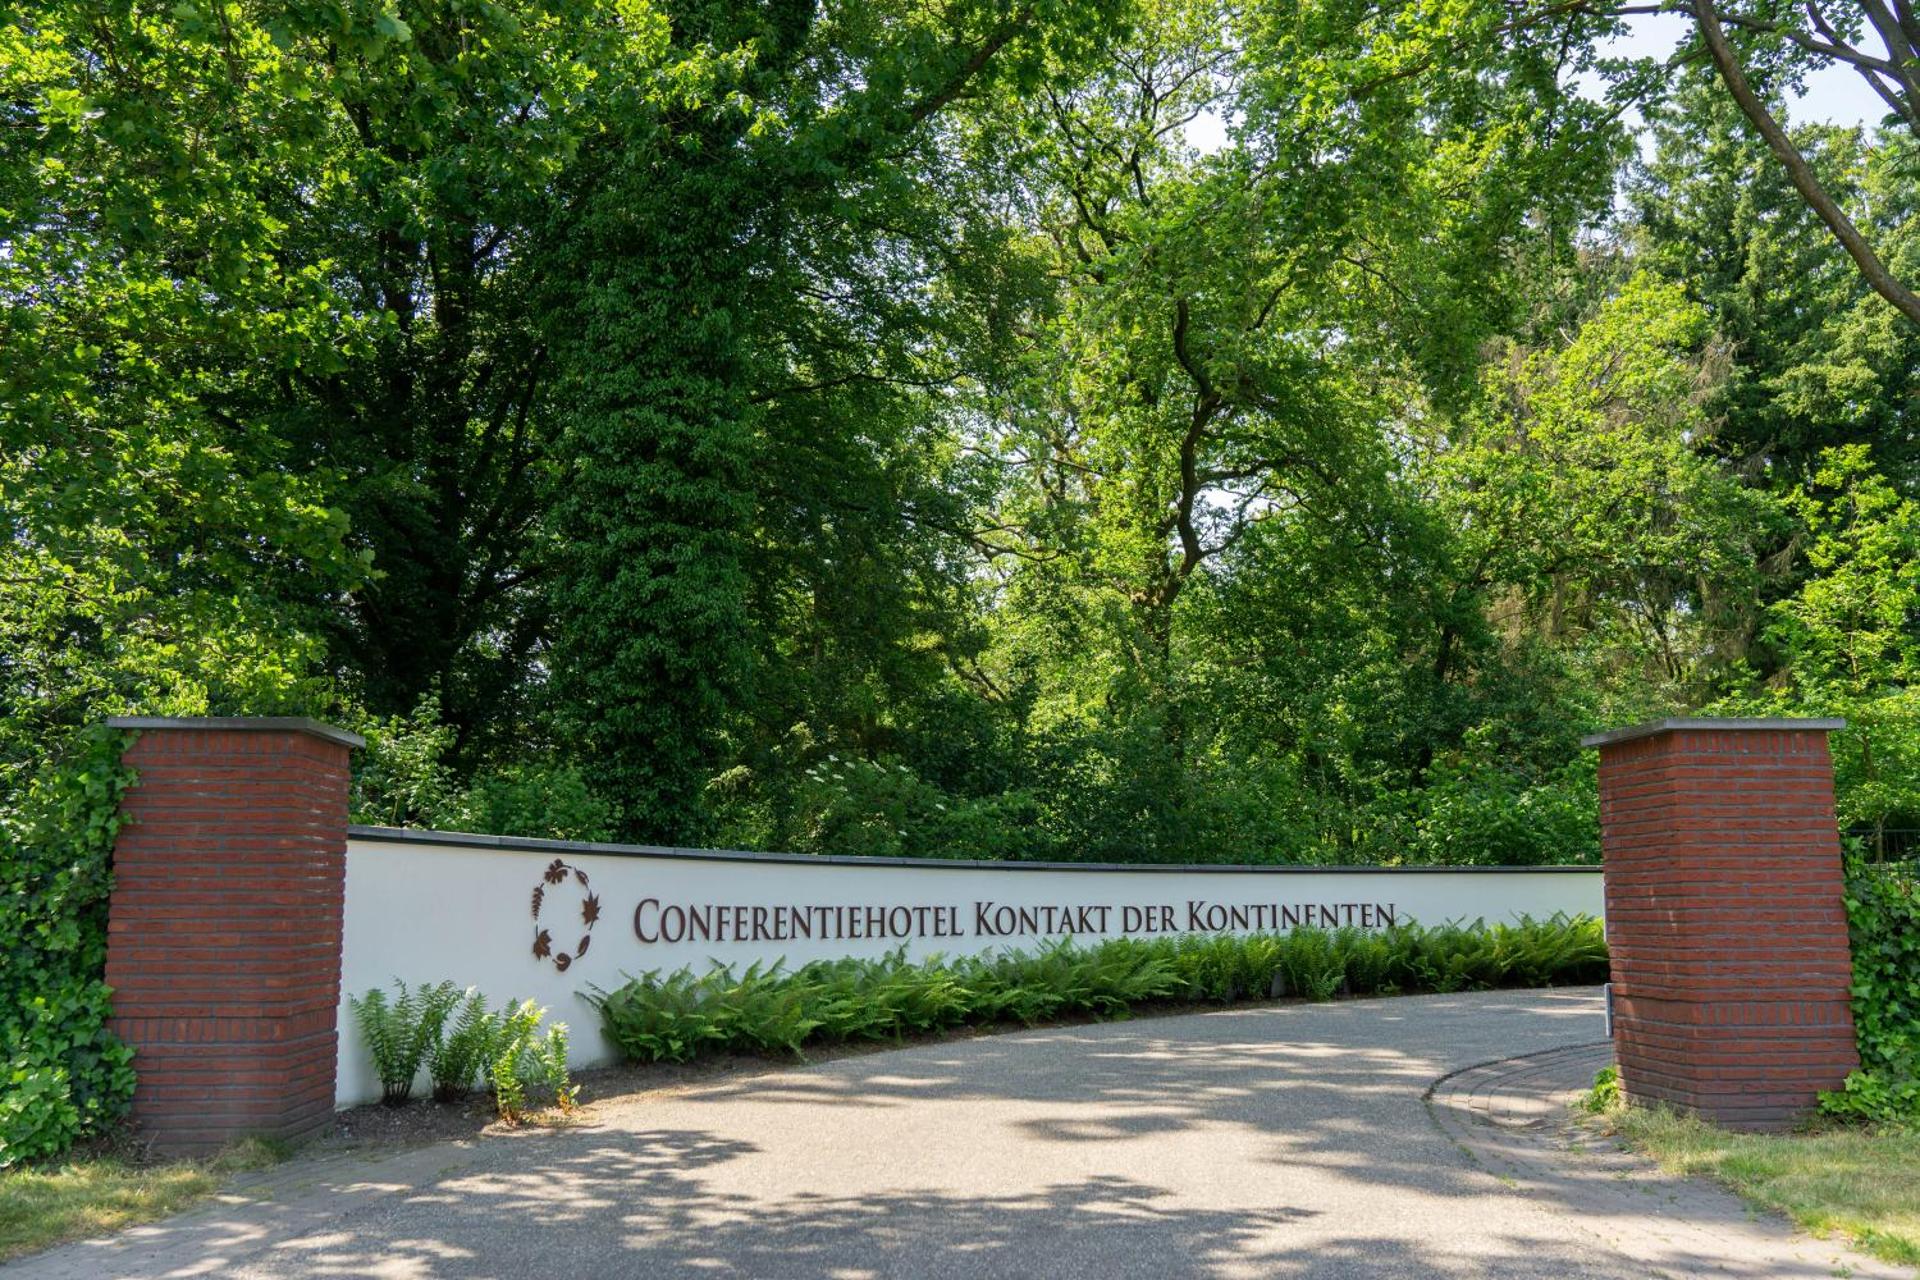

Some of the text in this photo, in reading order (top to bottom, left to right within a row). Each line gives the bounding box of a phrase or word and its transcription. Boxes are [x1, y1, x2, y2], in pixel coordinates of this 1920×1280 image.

[633, 898, 1396, 943] CONFERENTIEHOTEL KONTAKT DER KONTINENTEN
